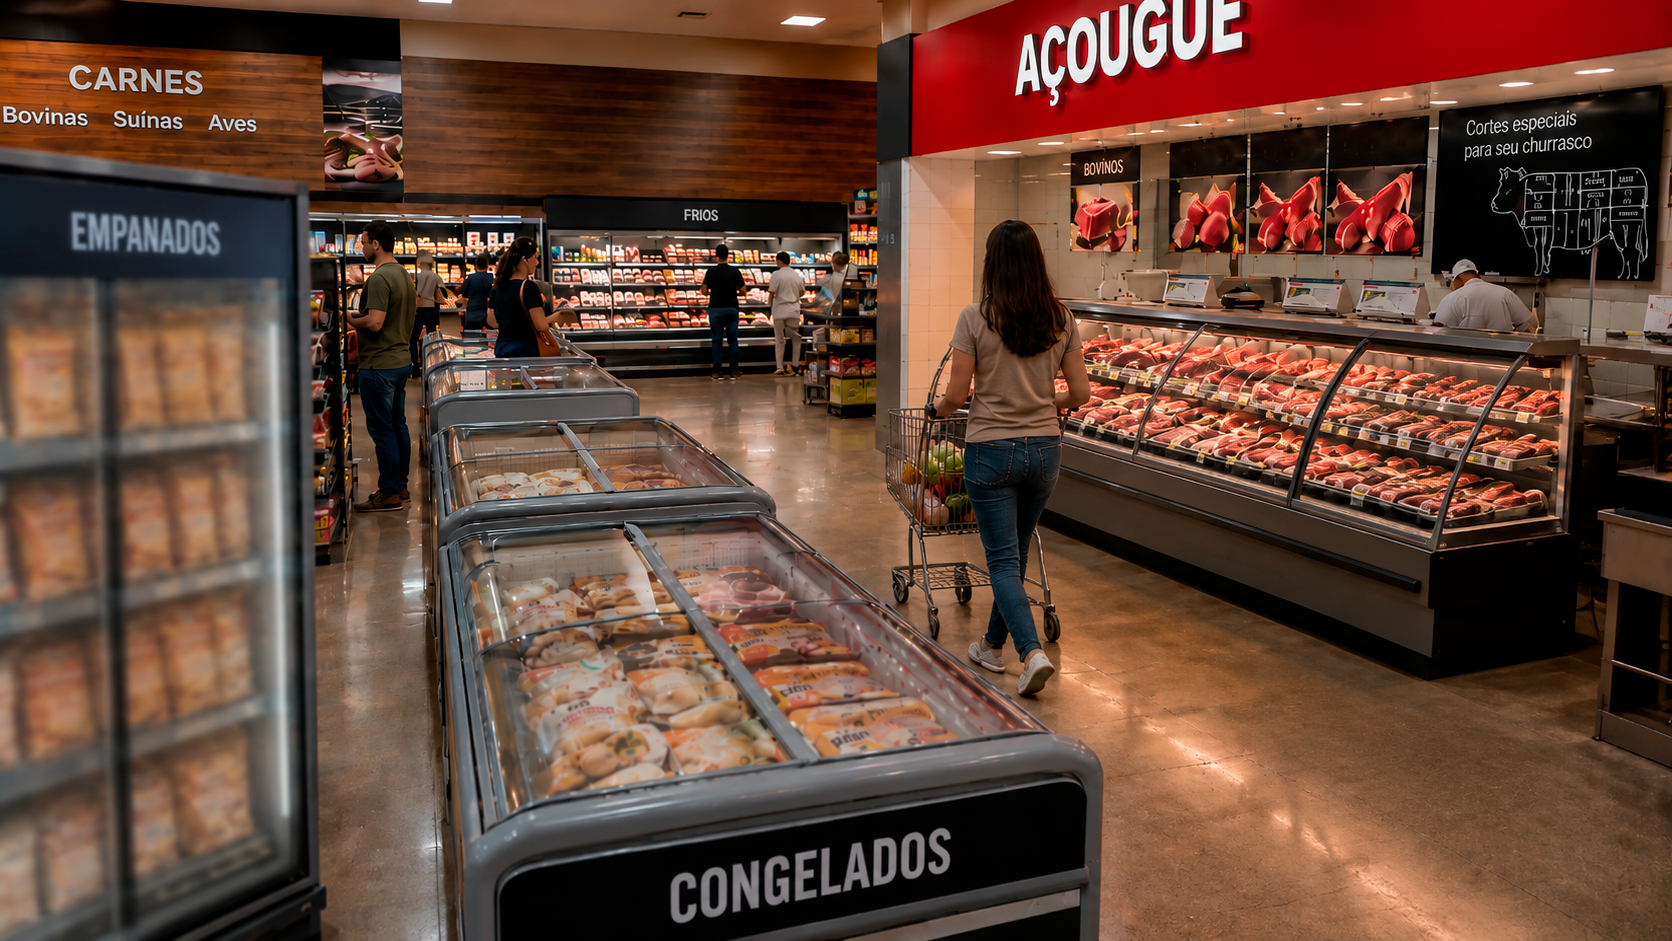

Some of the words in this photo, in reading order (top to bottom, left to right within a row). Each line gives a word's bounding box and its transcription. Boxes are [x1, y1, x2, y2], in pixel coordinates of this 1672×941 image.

[1015, 0, 1243, 107] AÇOUGUE
[68, 64, 204, 95] CARNES
[2, 105, 89, 127] Bovinas
[113, 110, 184, 130] Suínas
[208, 114, 257, 133] Aves
[1466, 119, 1509, 136] Cortes
[1512, 110, 1577, 134] especiais
[1464, 144, 1492, 162] para
[1495, 142, 1519, 156] seu
[1522, 136, 1593, 154] churrasco
[684, 208, 719, 222] FRIOS
[70, 211, 221, 257] EMPANADOS
[670, 827, 952, 924] CONGELADOS
